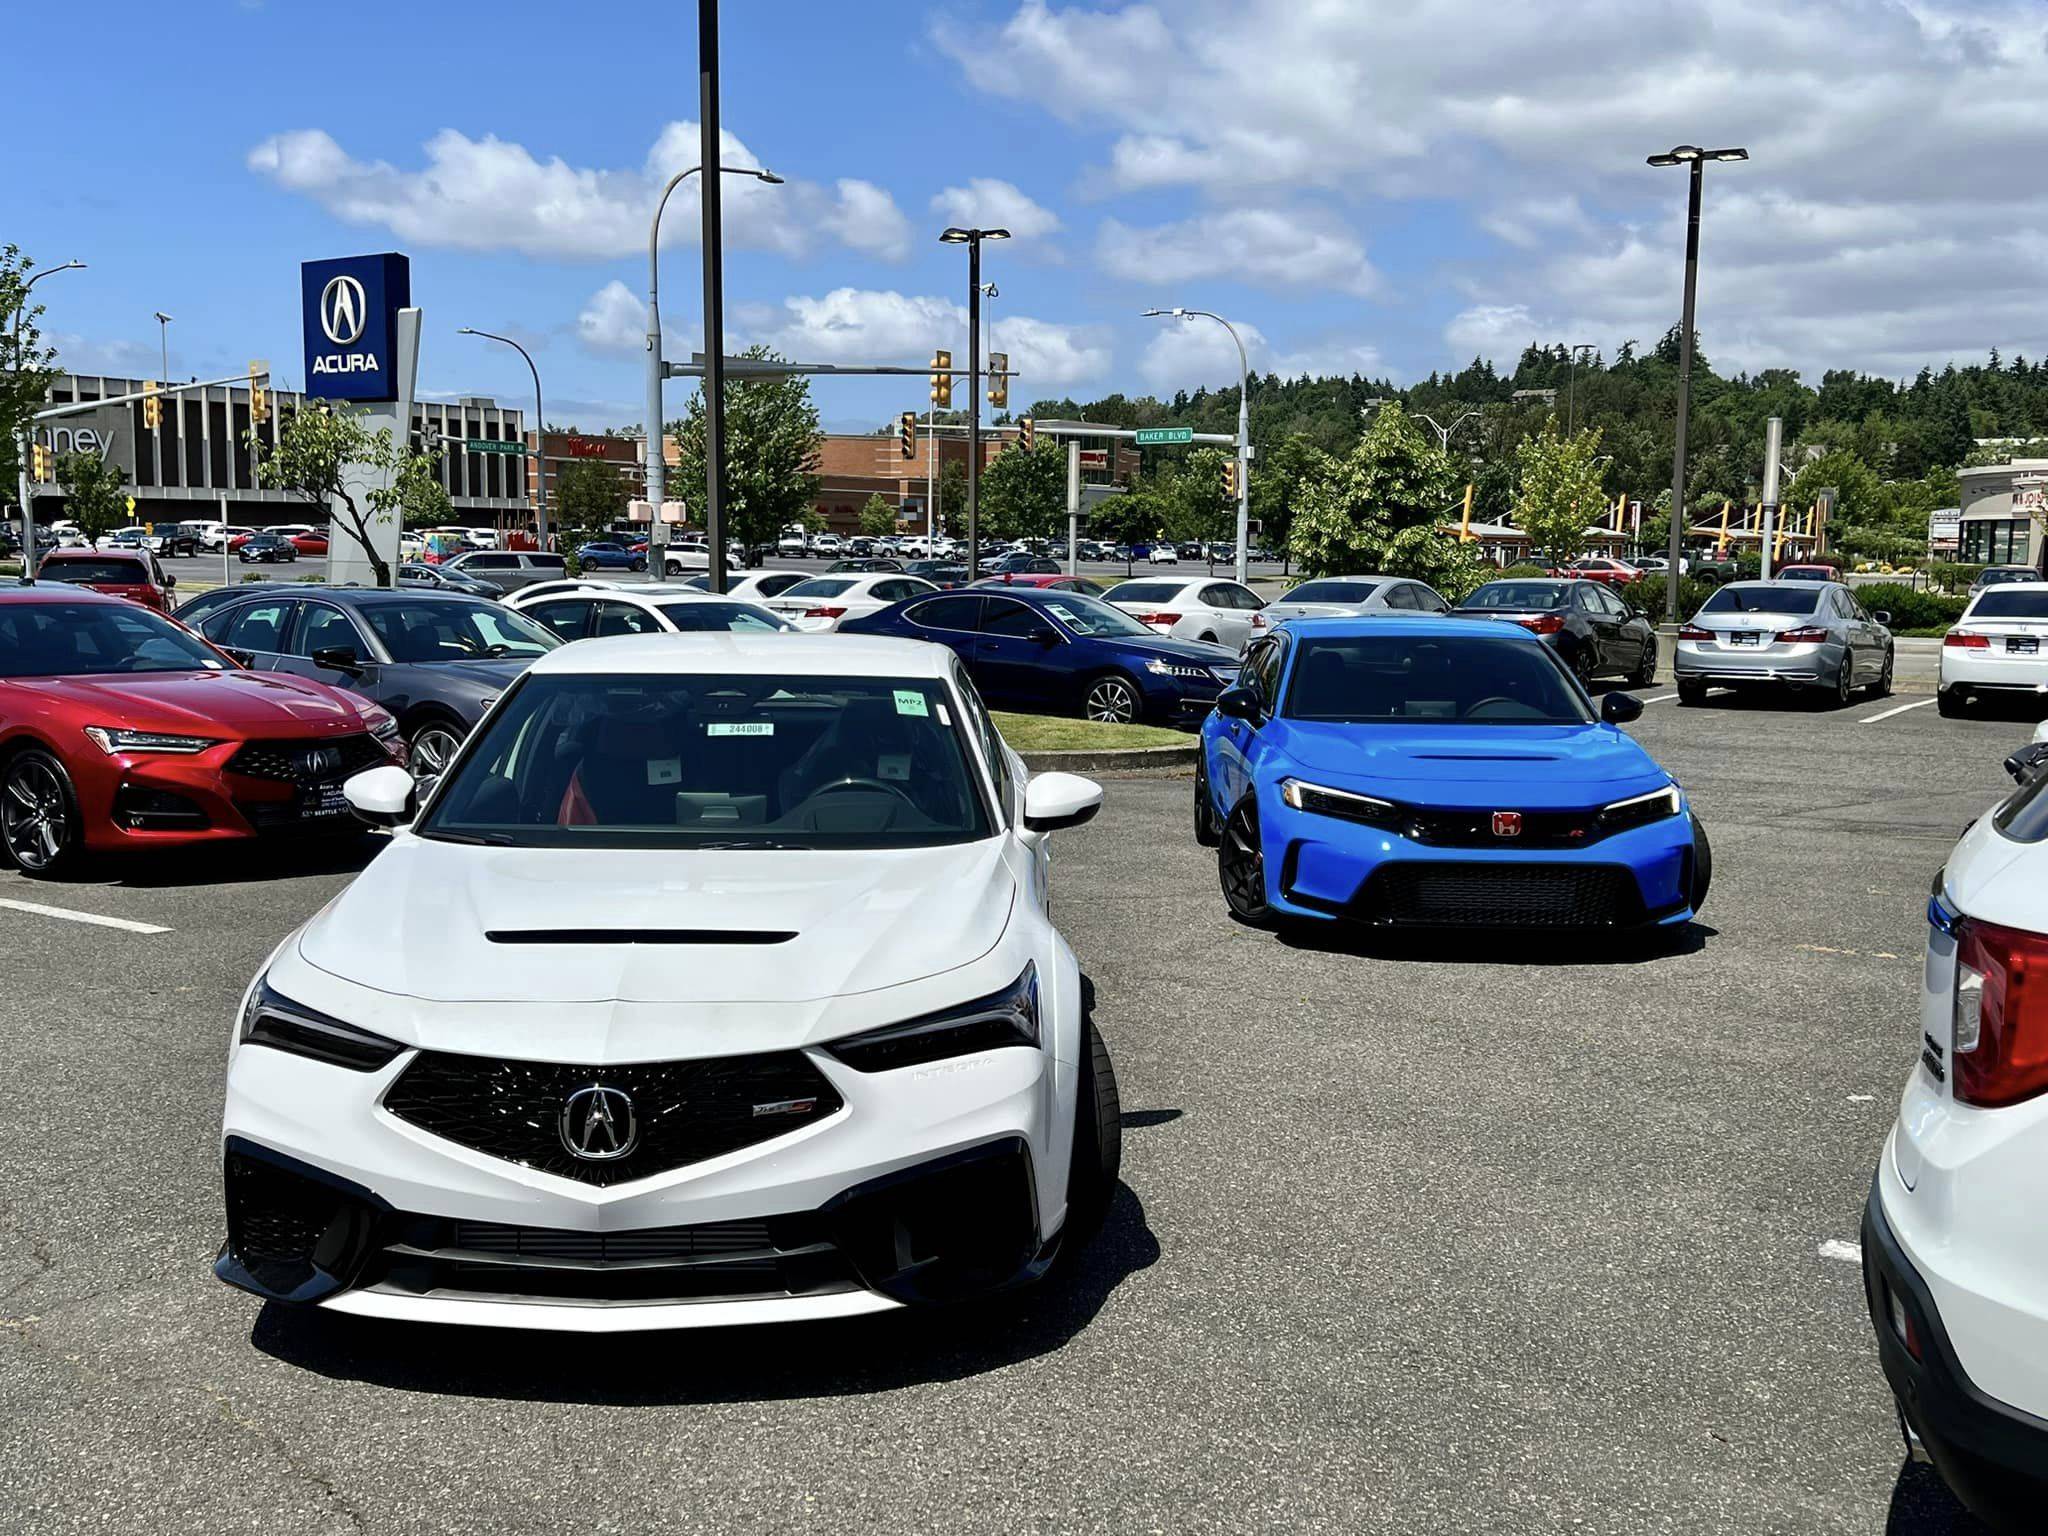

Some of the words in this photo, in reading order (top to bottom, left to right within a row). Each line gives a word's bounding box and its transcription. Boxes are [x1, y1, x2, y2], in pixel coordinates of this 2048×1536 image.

[312, 352, 379, 374] ACURA
[1140, 431, 1163, 440] BAKER
[1168, 431, 1187, 440] BLVD
